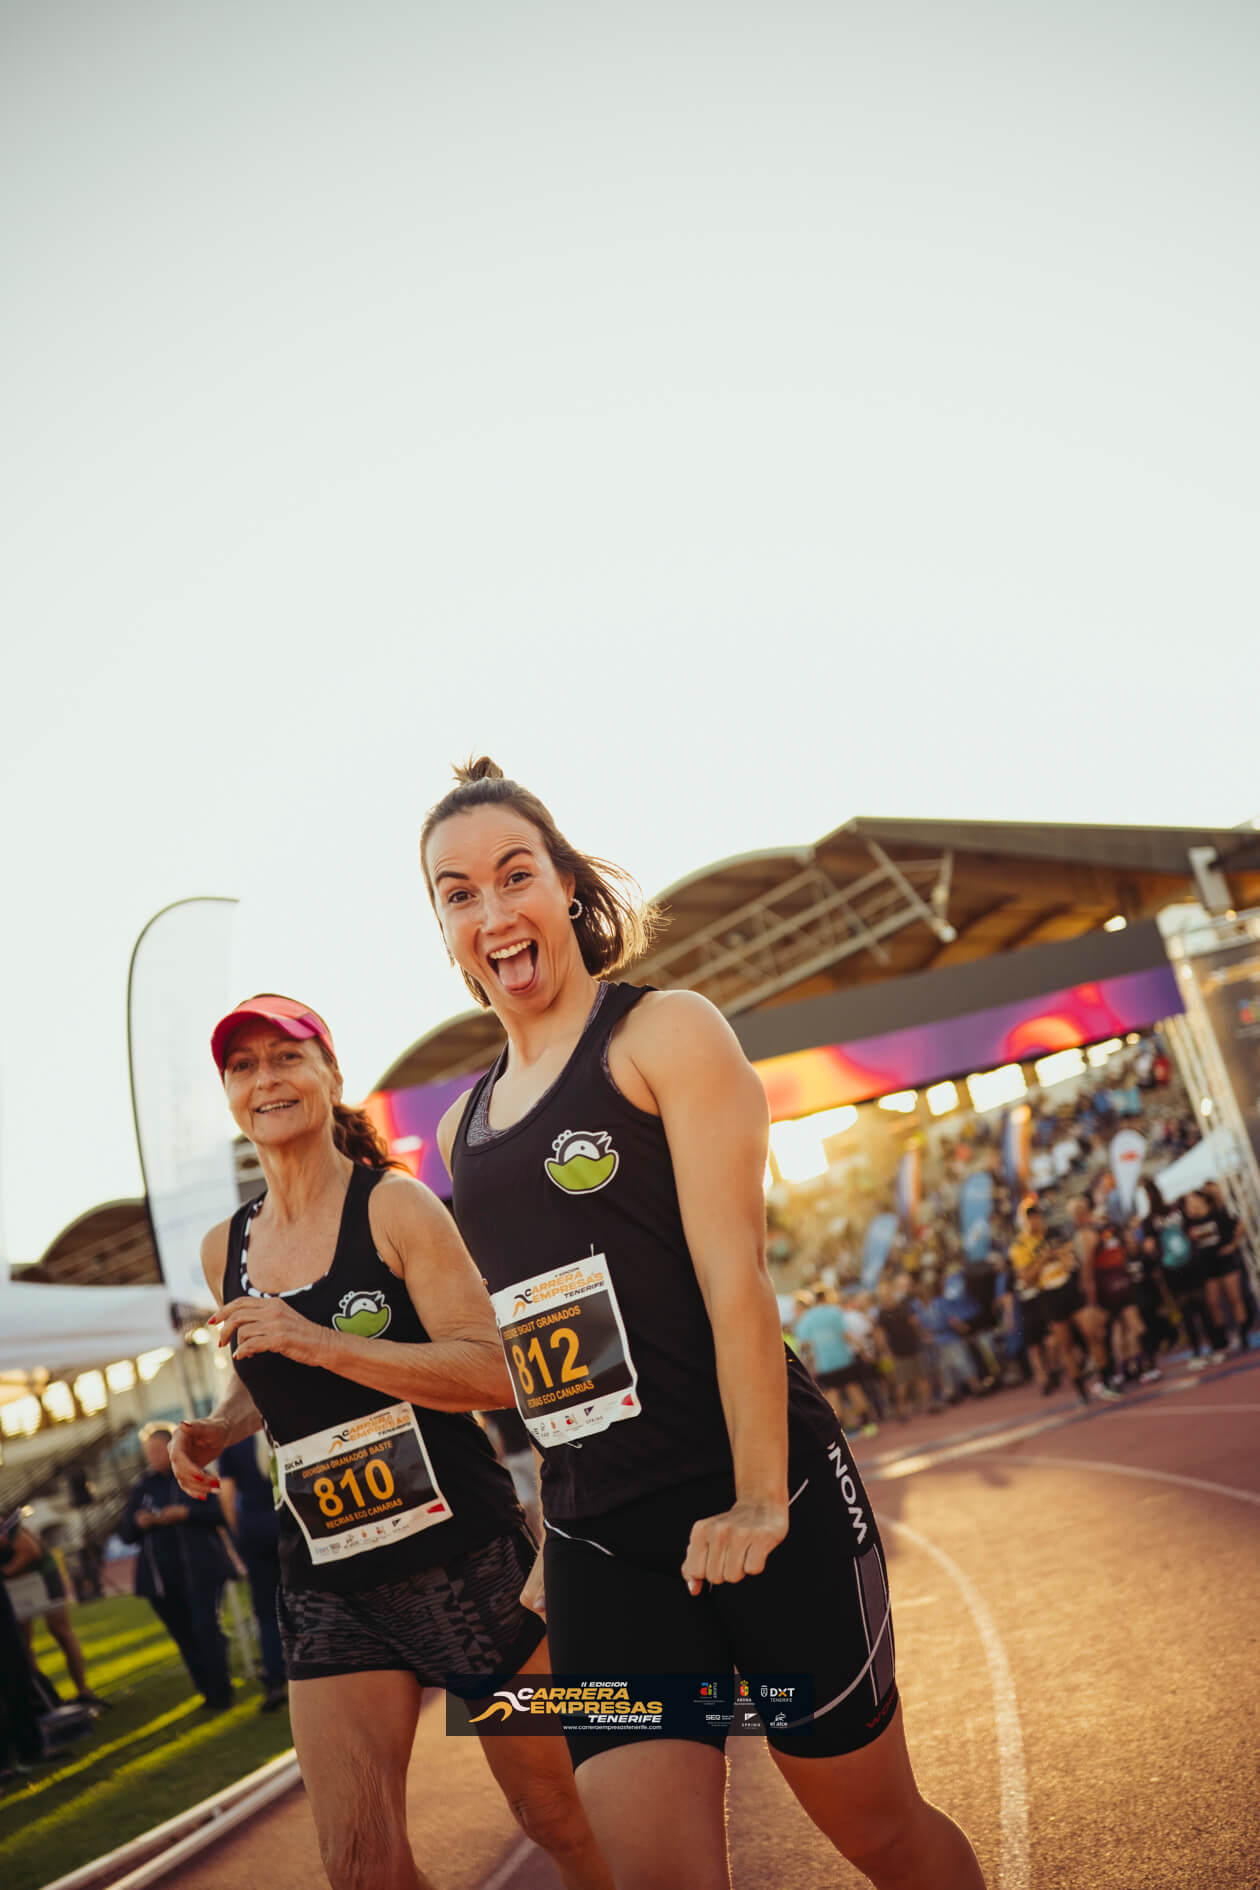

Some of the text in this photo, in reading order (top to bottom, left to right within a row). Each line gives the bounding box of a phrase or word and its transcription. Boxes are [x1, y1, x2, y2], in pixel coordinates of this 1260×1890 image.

[525, 1270, 583, 1297] CARRERA
[532, 1272, 605, 1303] EMPRESAS
[564, 1281, 604, 1299] TENERIFE
[536, 1305, 581, 1328] GRANADOS
[511, 1327, 589, 1395] 812
[556, 1380, 594, 1400] CANARIAS
[313, 1459, 395, 1517] 810
[367, 1498, 403, 1516] CANARIAS
